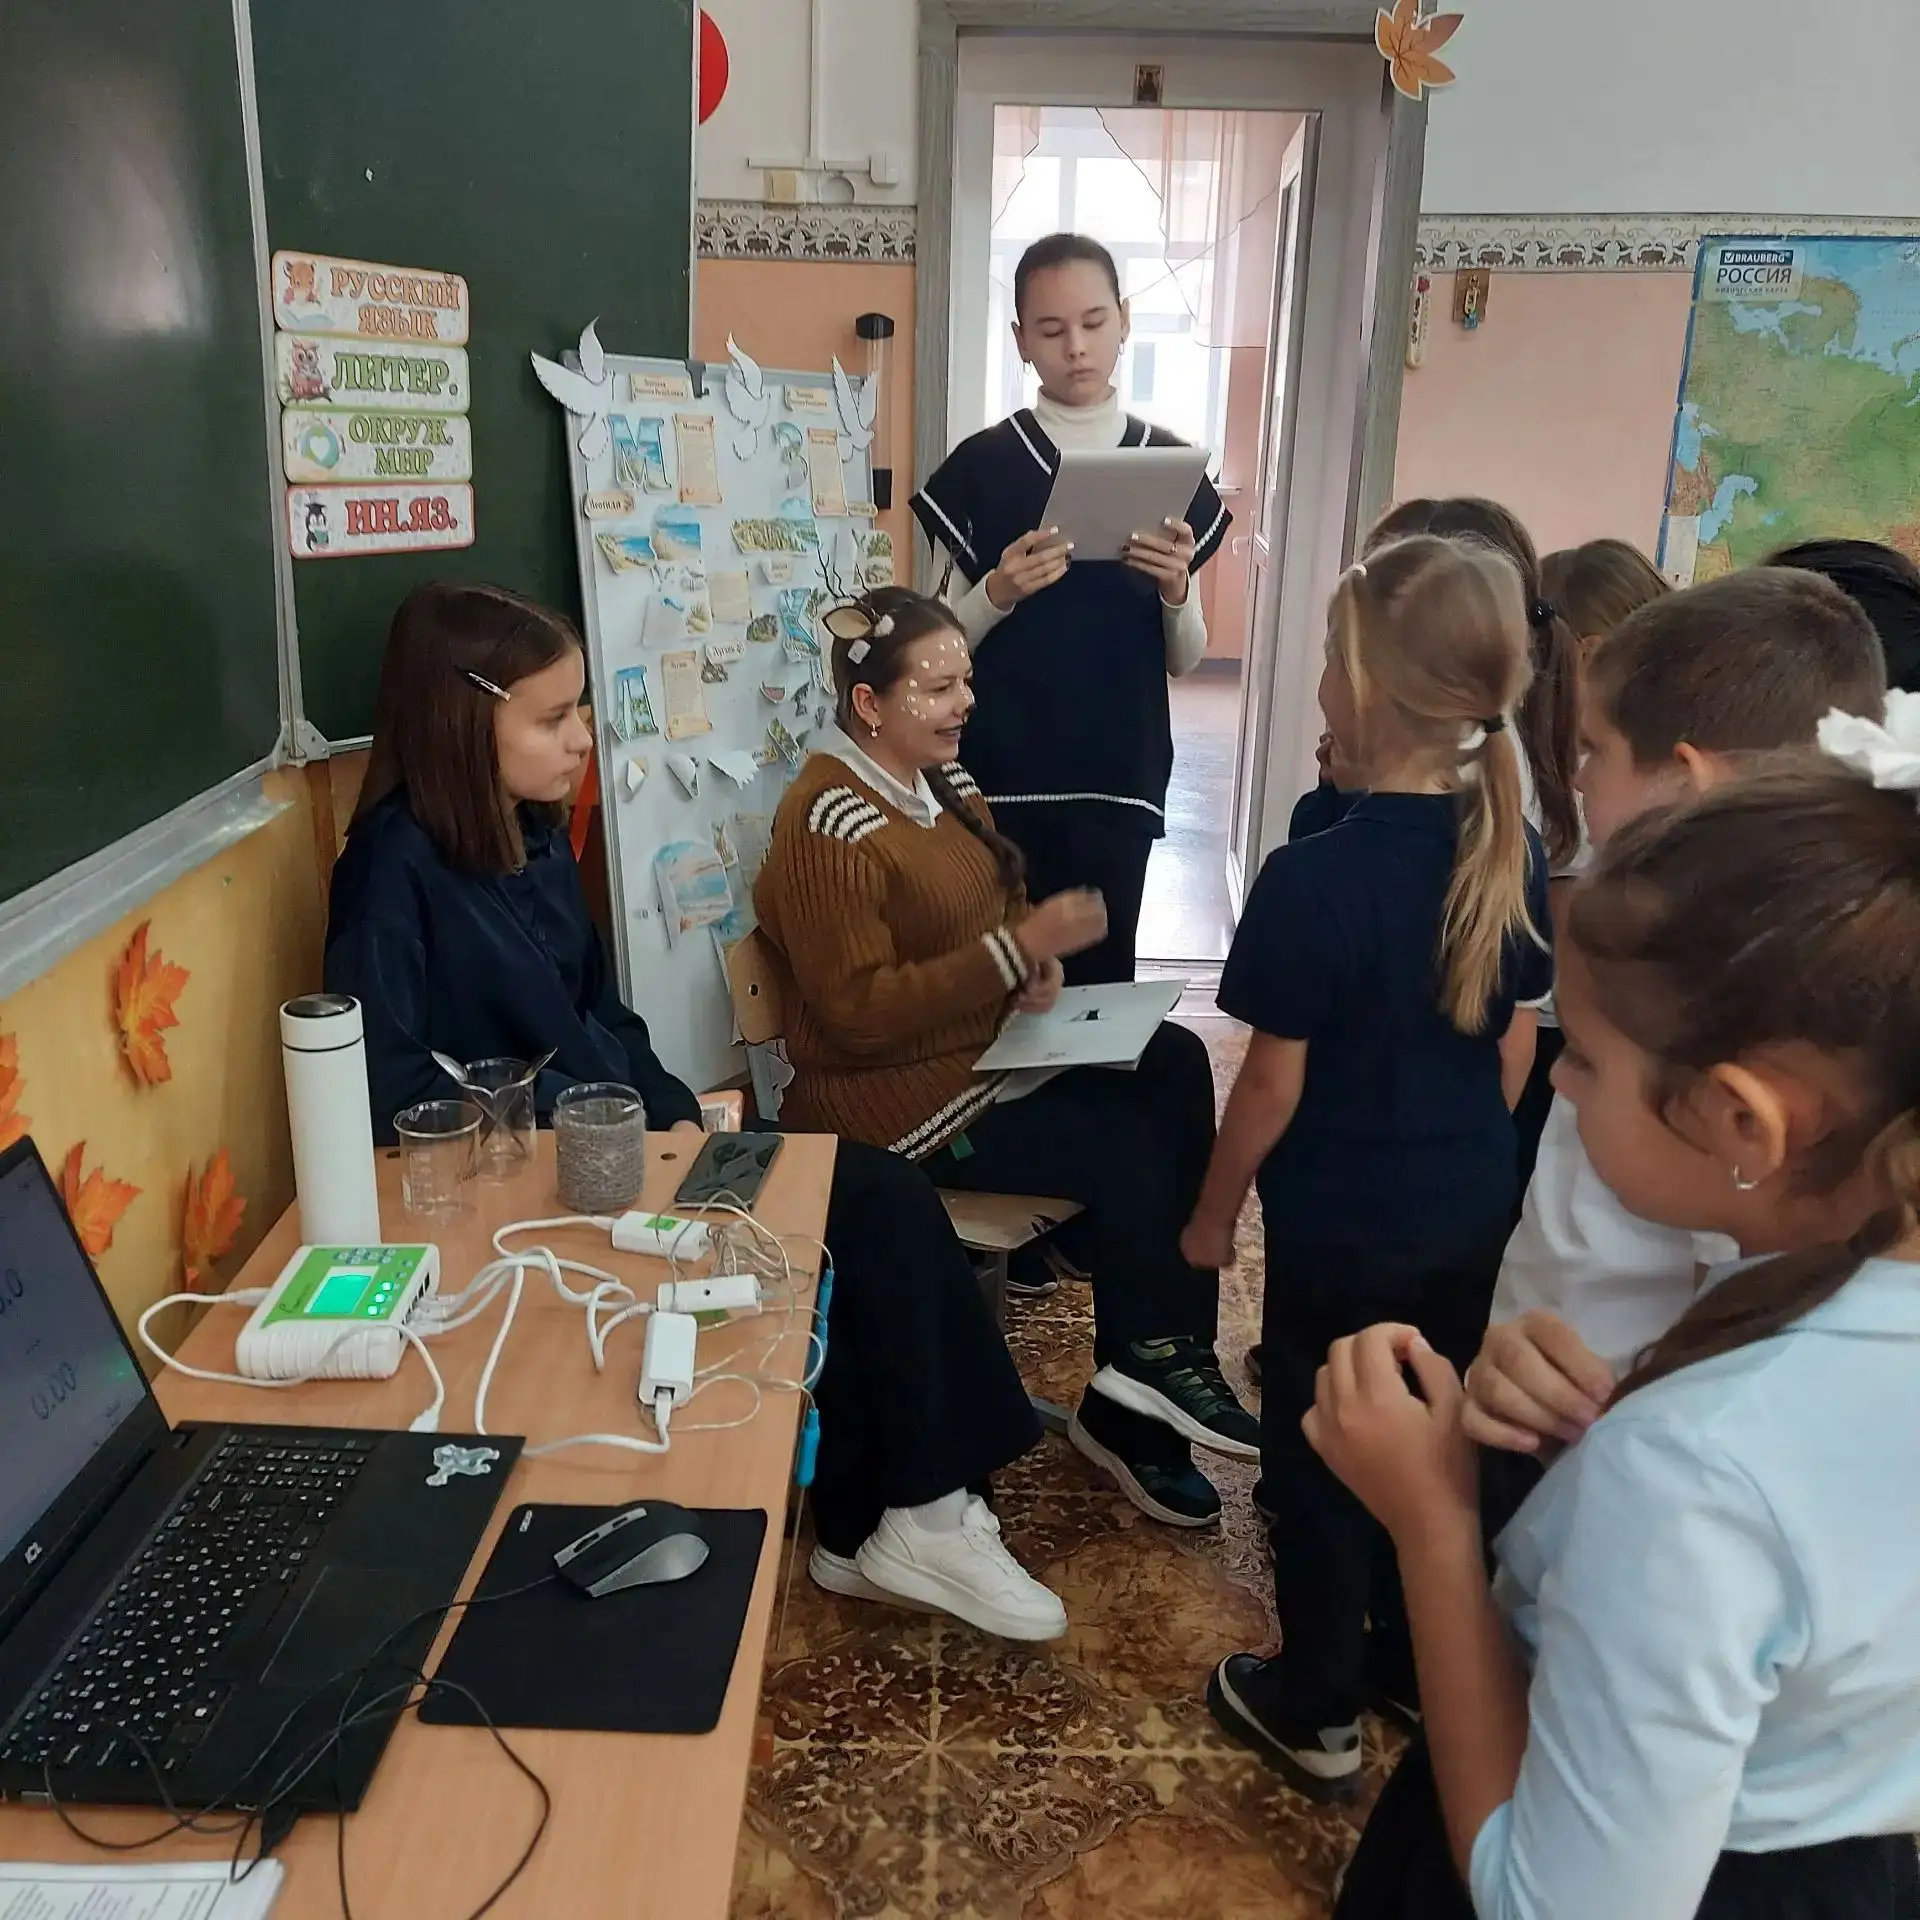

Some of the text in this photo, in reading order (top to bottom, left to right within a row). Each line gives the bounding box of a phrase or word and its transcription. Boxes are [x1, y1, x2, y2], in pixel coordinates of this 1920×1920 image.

[1735, 253, 1785, 263] BRAUBERG
[329, 265, 461, 310] РУССКИЙ
[1717, 268, 1792, 284] РОССИЯ
[358, 304, 439, 339] ЯЗЫК
[331, 352, 459, 396] ЛИТЕР.
[348, 414, 454, 446] ОКРУЖ.
[374, 447, 434, 476] МИР
[344, 496, 458, 536] ИН.ЯЗ.
